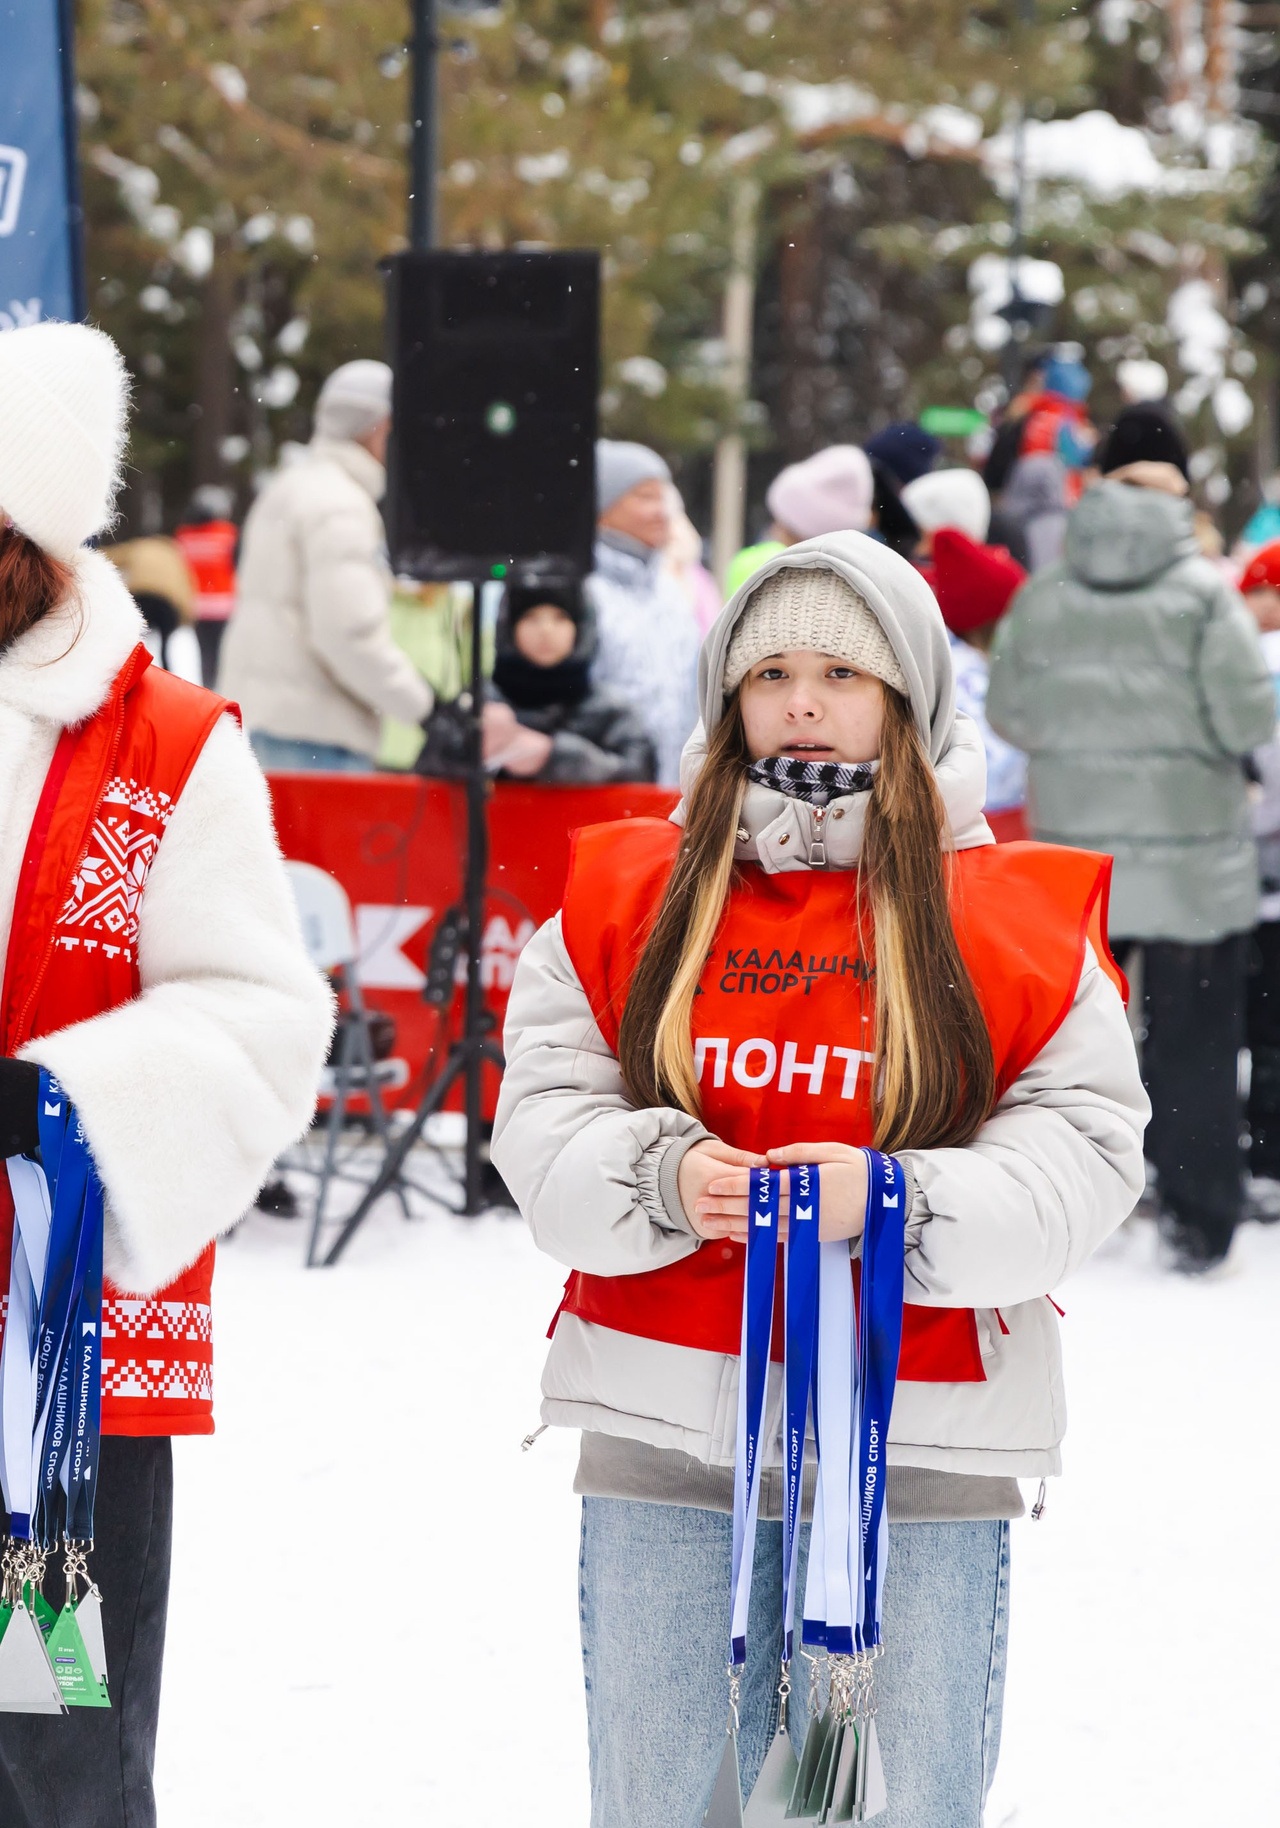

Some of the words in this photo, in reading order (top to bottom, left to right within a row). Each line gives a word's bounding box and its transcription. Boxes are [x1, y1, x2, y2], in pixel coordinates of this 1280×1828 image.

[719, 972, 818, 996] СПОРТ
[39, 1328, 55, 1369] СПОРТ
[77, 1345, 93, 1437] КАЛАШНИКОВ
[72, 1439, 84, 1482] СПОРТ
[791, 1427, 799, 1471] СПОРТ
[868, 1418, 879, 1462] СПОРТ
[46, 1451, 58, 1490] СПОРТ
